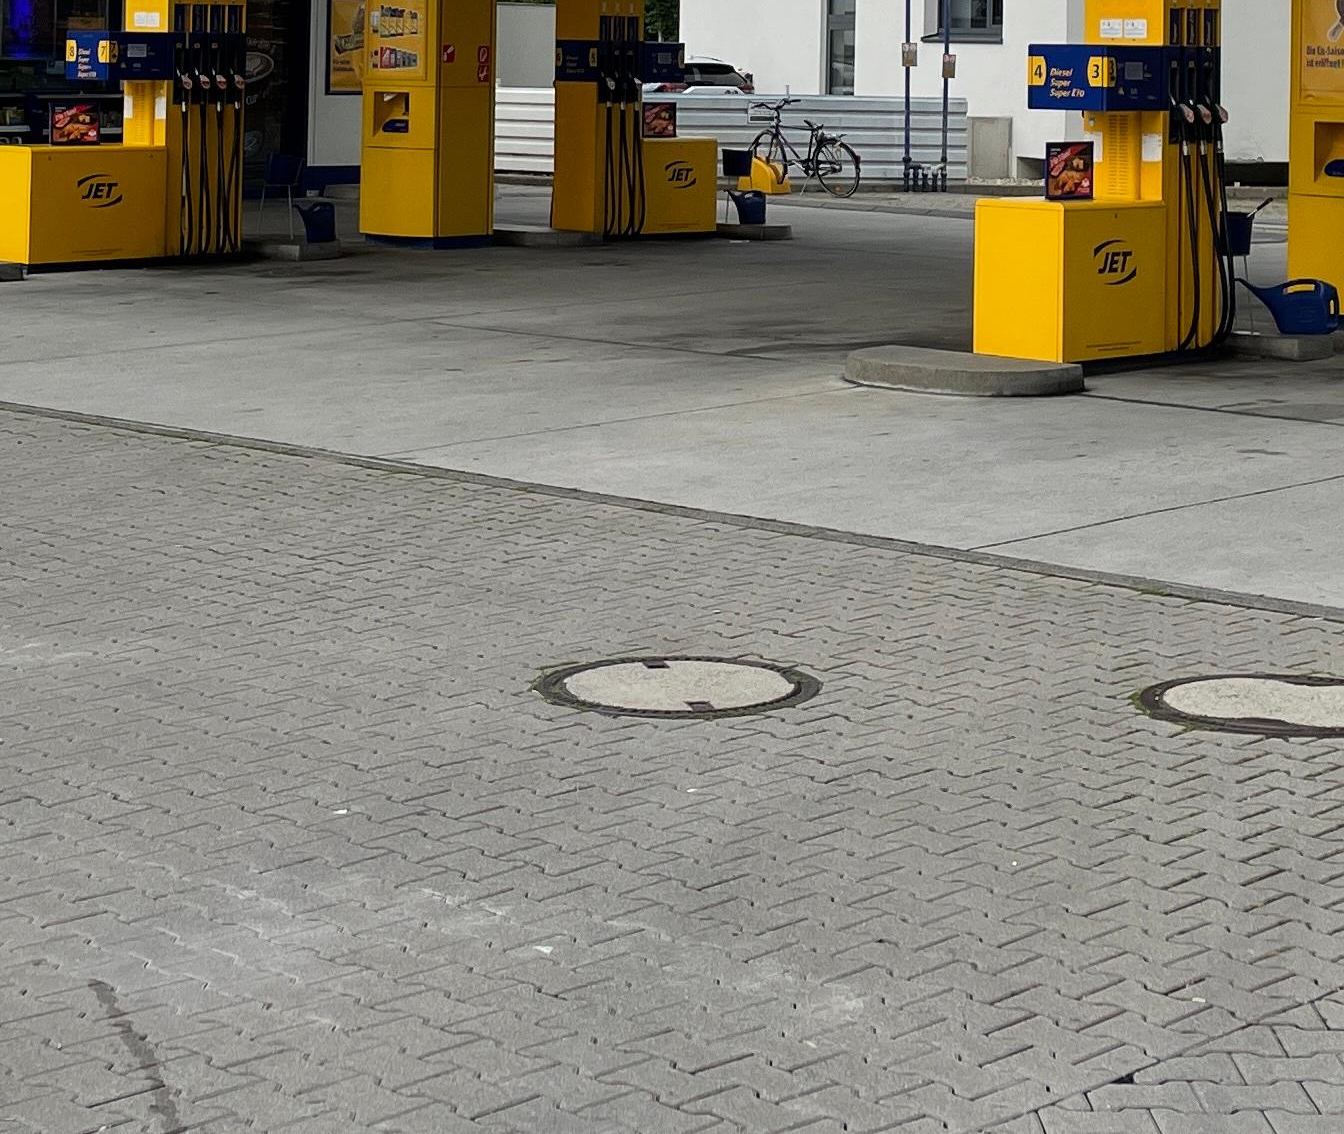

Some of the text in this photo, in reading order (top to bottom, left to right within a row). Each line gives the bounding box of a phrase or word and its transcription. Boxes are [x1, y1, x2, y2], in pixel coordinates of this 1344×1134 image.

[1034, 65, 1043, 79] 4
[1050, 68, 1073, 77] Diesel
[1092, 64, 1099, 79] 3
[1050, 78, 1071, 88] Super
[1049, 88, 1085, 99] Super E10
[667, 167, 694, 182] JET
[81, 182, 118, 200] JET
[1097, 250, 1133, 275] JET
